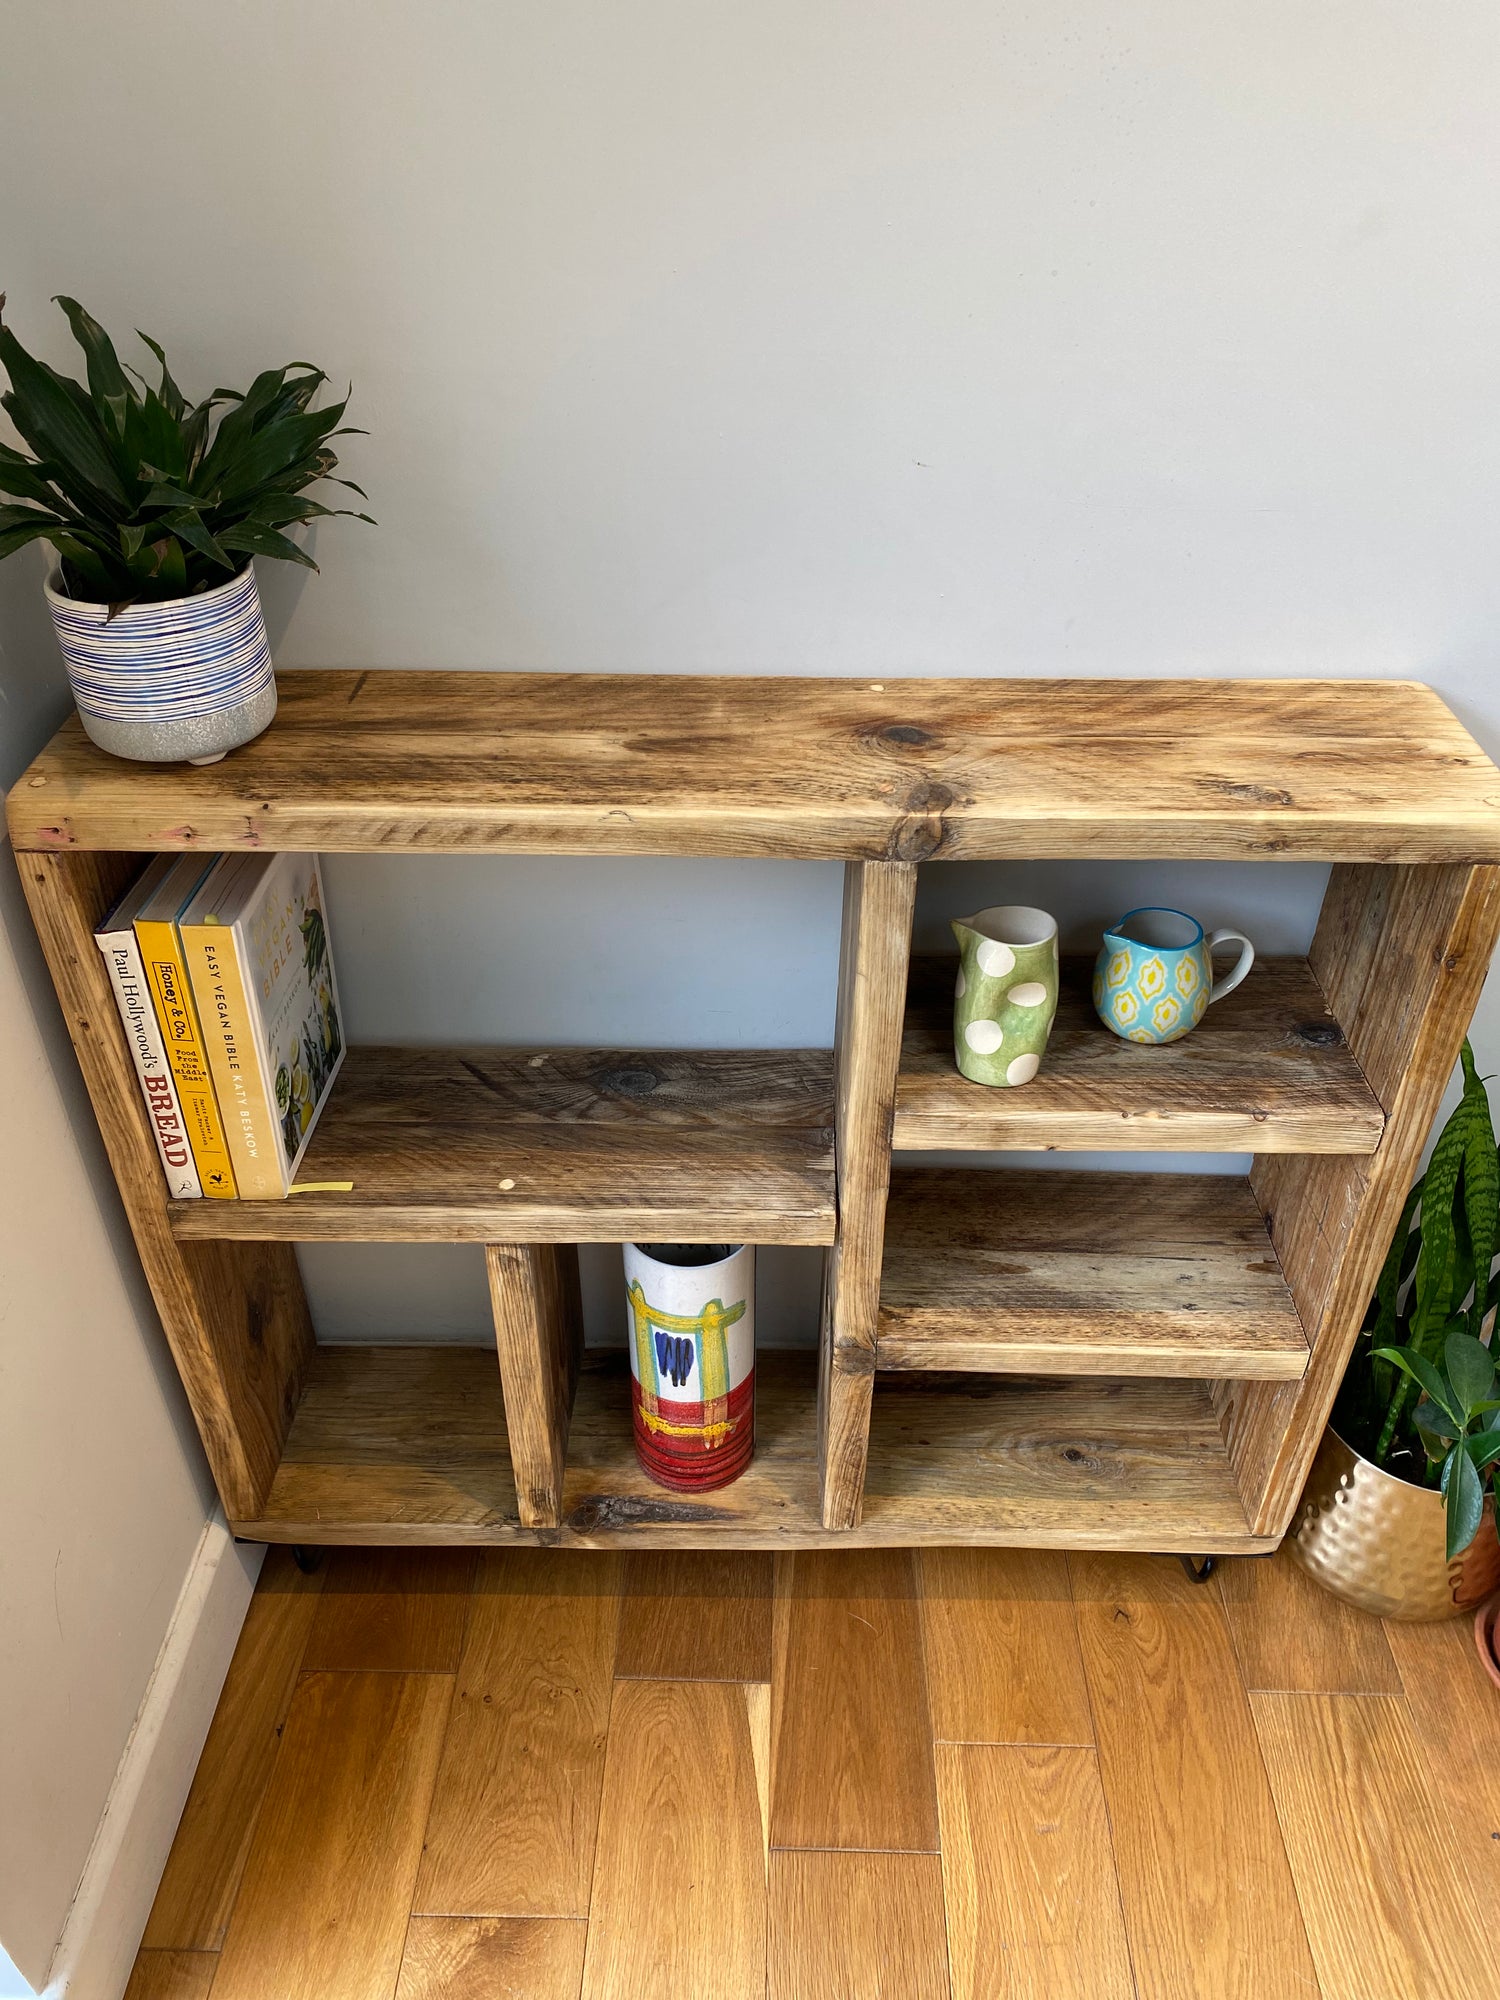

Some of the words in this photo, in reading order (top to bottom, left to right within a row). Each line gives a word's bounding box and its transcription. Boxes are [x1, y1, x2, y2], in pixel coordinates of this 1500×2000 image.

[112, 948, 132, 980] Paul
[204, 945, 221, 979] EASY
[263, 934, 292, 998] BIBLE
[160, 964, 178, 1006] Honey
[171, 1007, 184, 1018] &
[213, 984, 232, 1029] VEGAN
[121, 983, 159, 1070] Hollywood's
[173, 1020, 187, 1039] Co.
[175, 1049, 197, 1057] Food
[176, 1055, 199, 1063] From
[223, 1034, 240, 1070] BIBLE
[174, 1068, 207, 1076] Middle
[232, 1074, 249, 1106] KATY
[143, 1074, 189, 1168] BREAD
[239, 1110, 259, 1159] BESKOW
